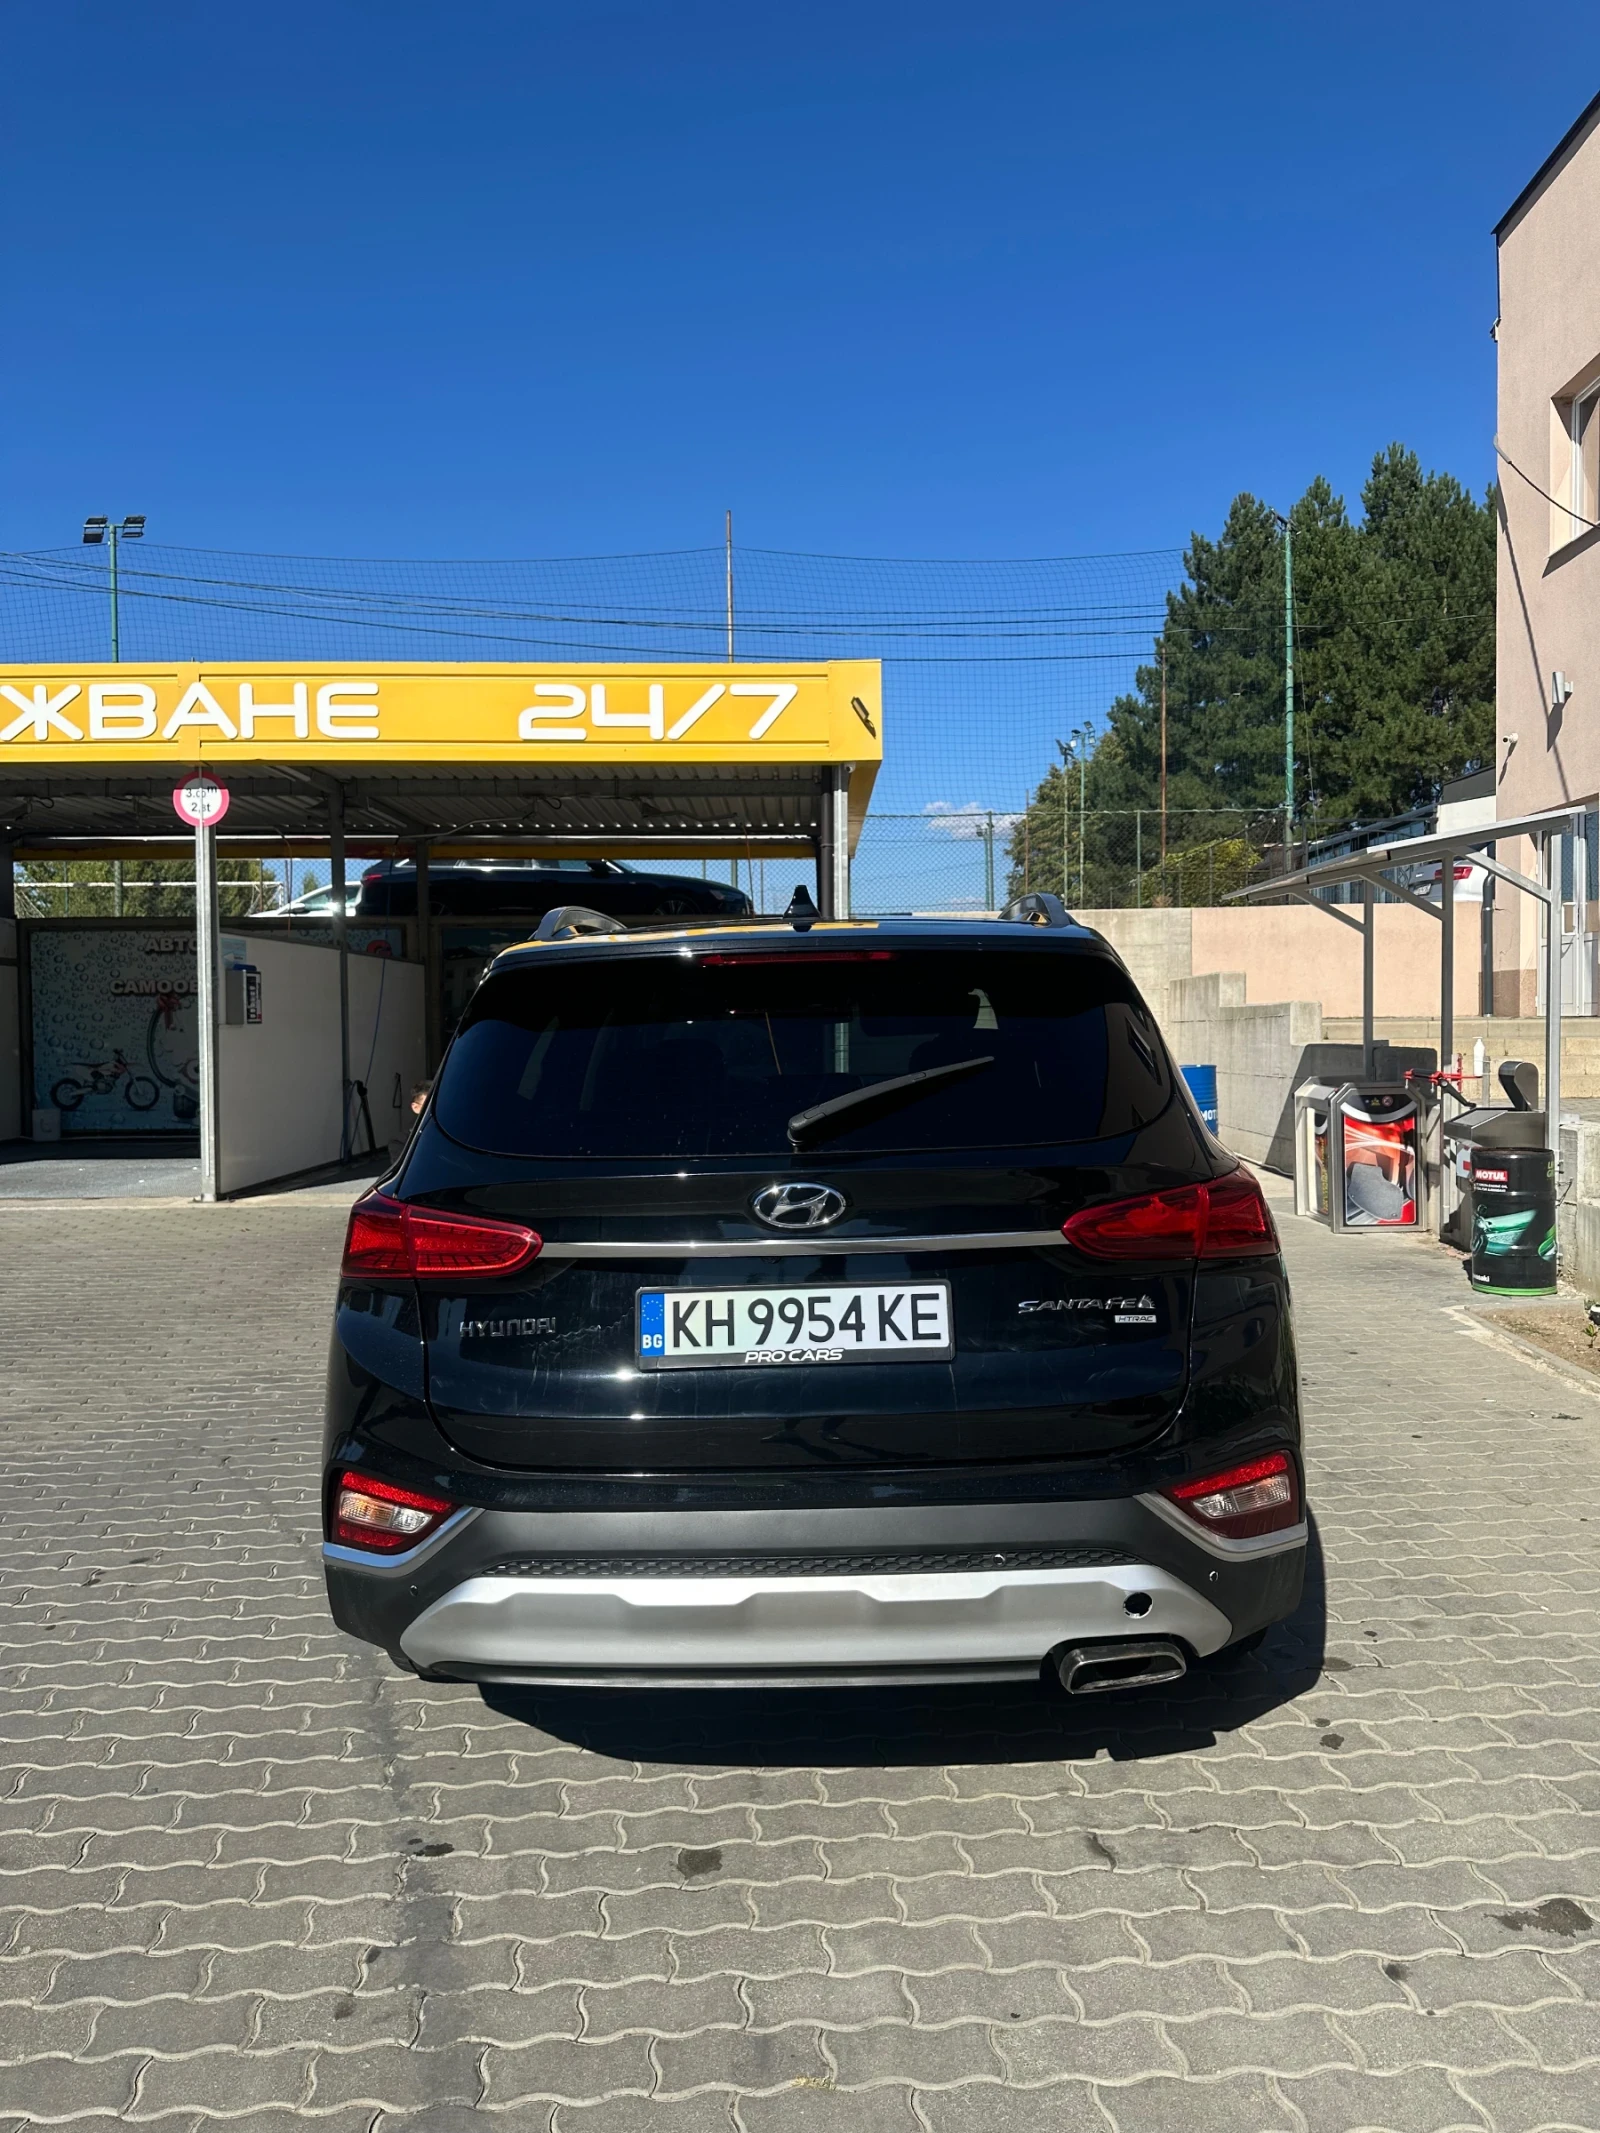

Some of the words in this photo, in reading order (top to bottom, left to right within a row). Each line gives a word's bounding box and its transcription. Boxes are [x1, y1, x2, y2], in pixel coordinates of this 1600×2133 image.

[0, 682, 380, 741] ЖВАНЕ
[518, 683, 798, 740] 24/7
[1475, 1169, 1506, 1181] MOTUL
[460, 1317, 556, 1337] HYUNDAI
[748, 1295, 866, 1345] 9954
[642, 1334, 663, 1348] BG
[745, 1351, 786, 1363] PRO
[788, 1349, 844, 1362] CARS
